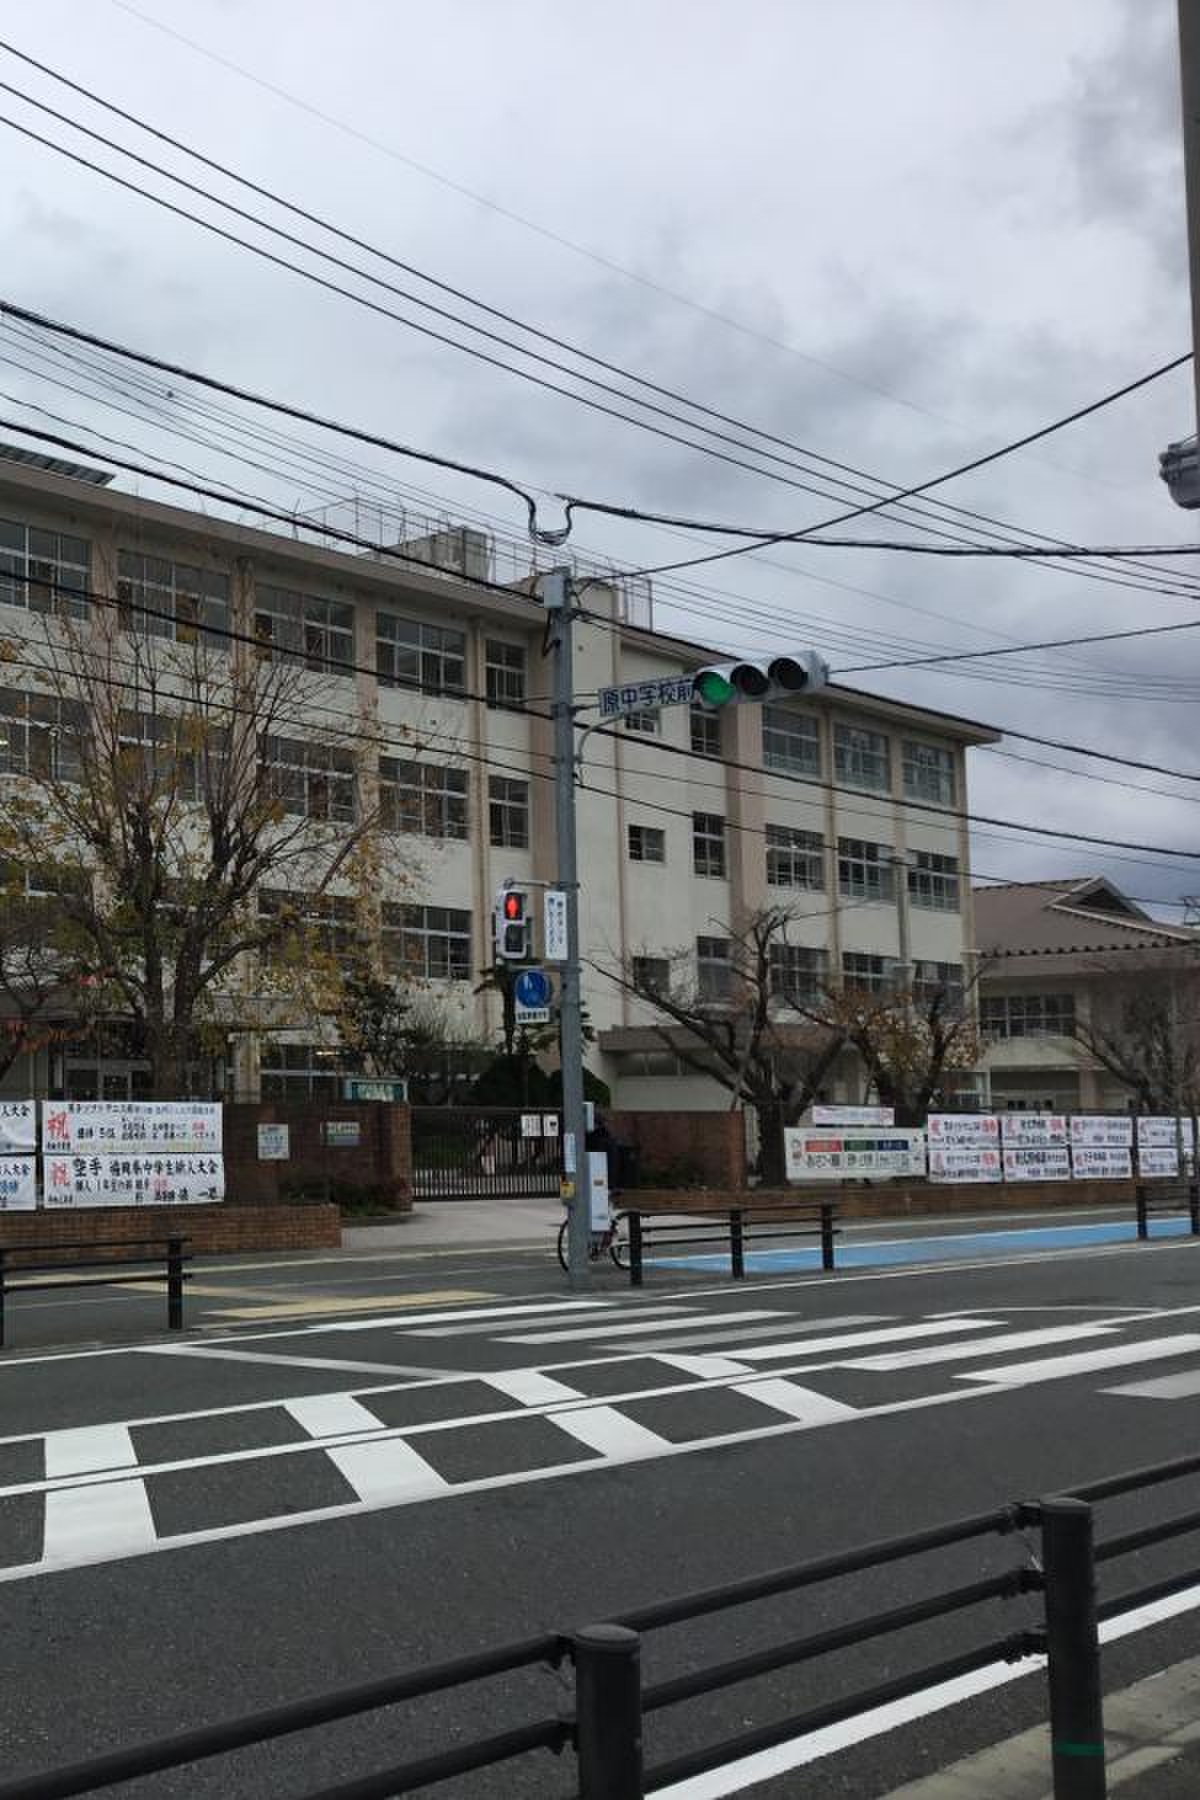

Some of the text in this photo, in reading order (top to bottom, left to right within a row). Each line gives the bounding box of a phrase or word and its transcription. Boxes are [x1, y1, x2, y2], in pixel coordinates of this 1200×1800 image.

[603, 678, 694, 712] 原中学校前
[47, 1110, 70, 1140] 祝
[72, 1157, 103, 1178] 空手
